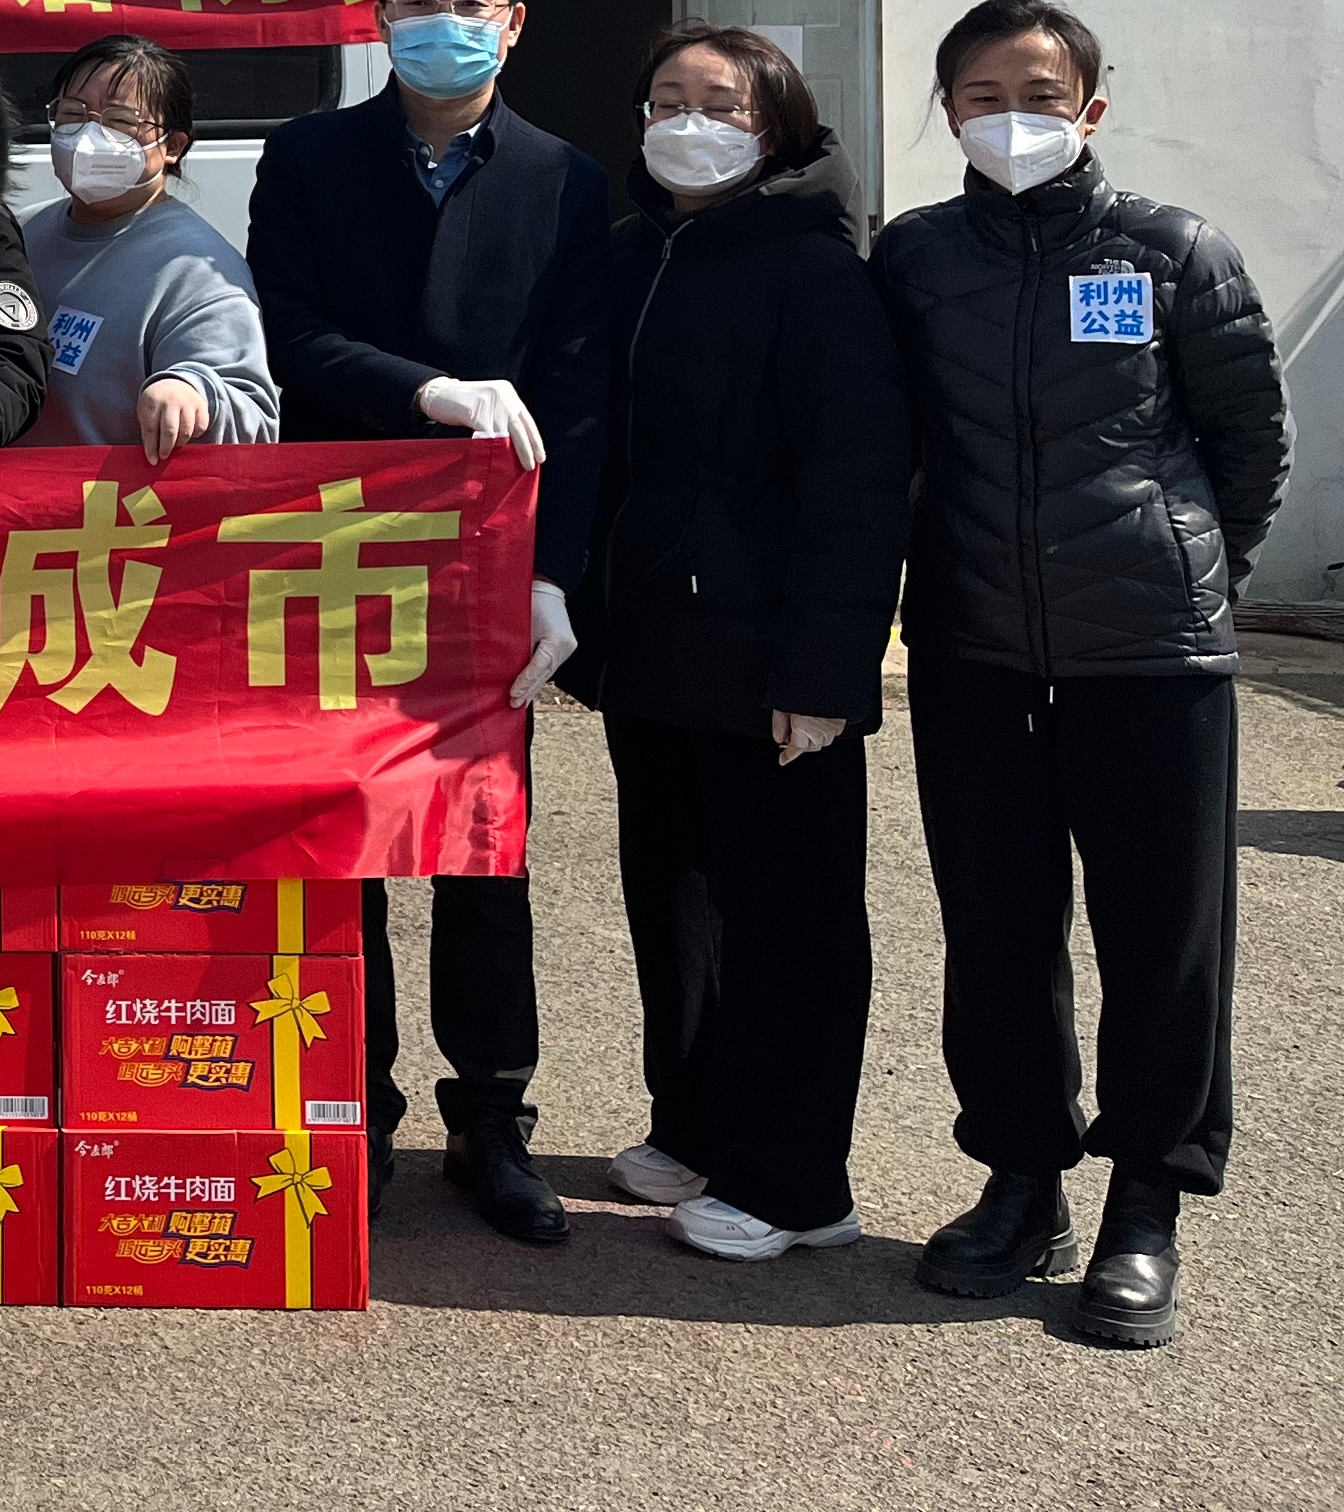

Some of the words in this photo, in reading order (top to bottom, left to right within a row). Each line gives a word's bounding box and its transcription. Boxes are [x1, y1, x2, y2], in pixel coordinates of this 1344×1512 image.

[1079, 279, 1143, 307] 利州
[53, 312, 96, 343] 利州
[1080, 309, 1144, 336] 公益
[105, 998, 237, 1025] 红烧牛肉面
[104, 1174, 236, 1202] 红烧牛肉面
